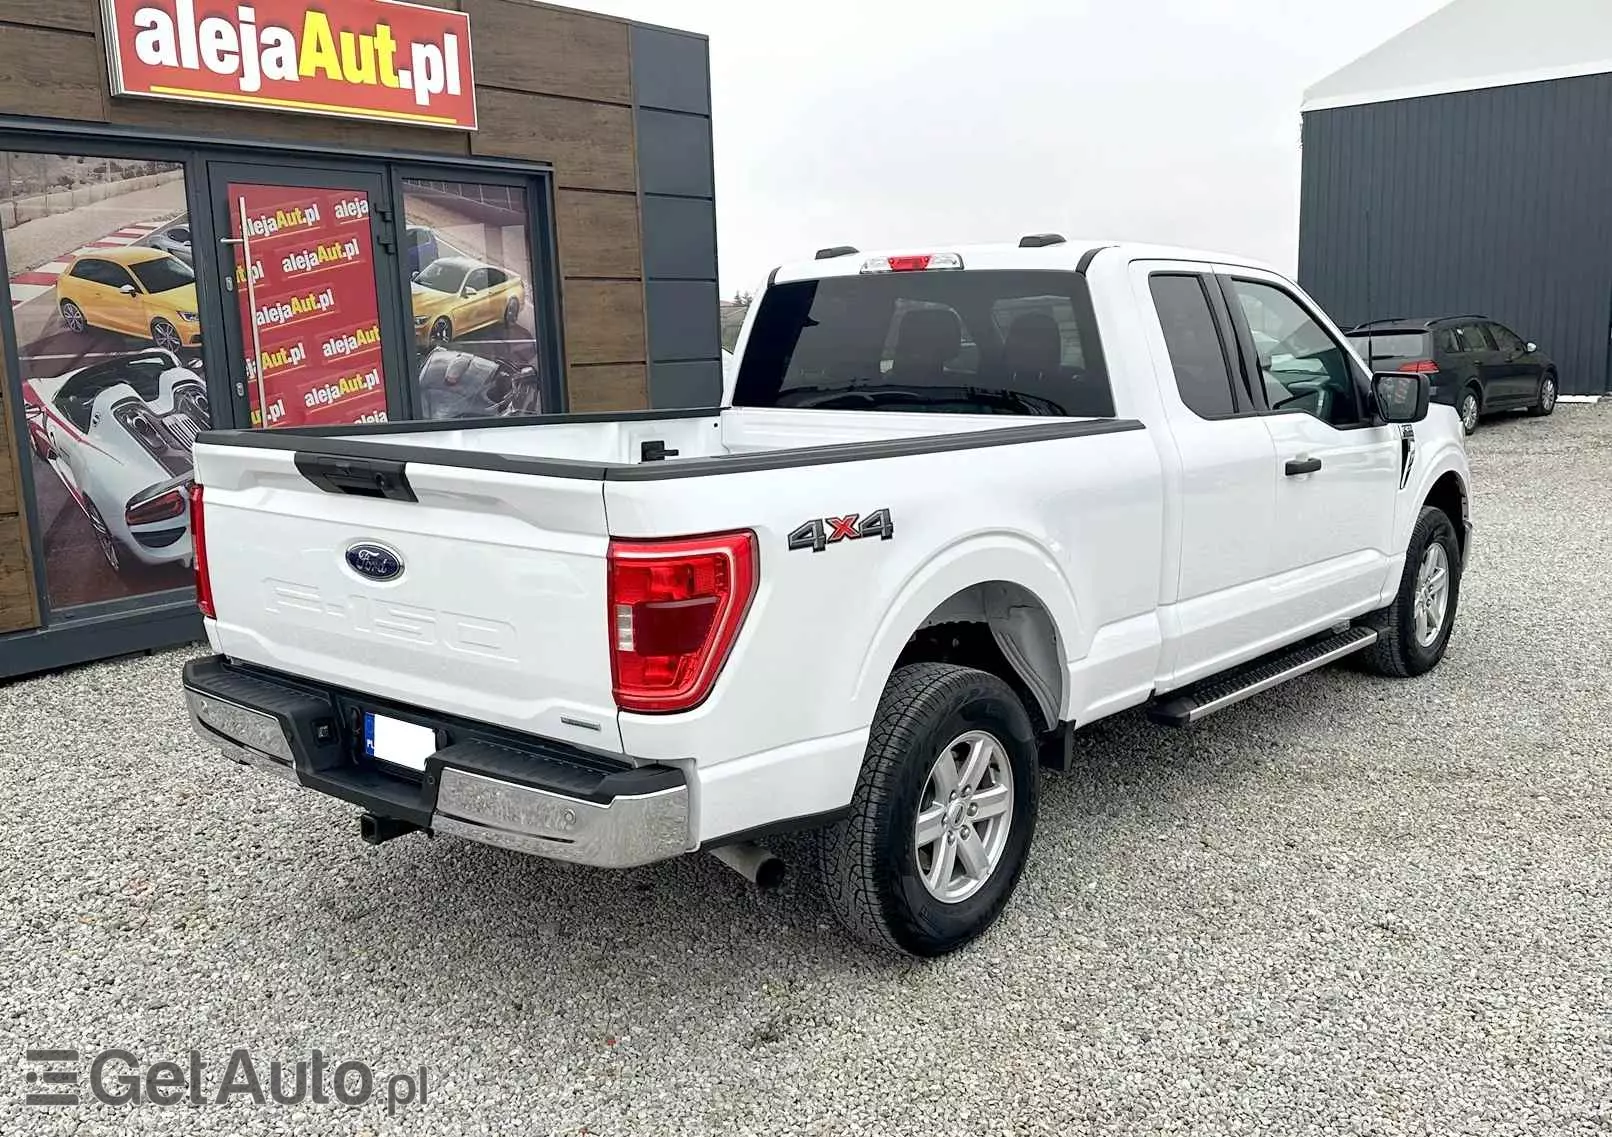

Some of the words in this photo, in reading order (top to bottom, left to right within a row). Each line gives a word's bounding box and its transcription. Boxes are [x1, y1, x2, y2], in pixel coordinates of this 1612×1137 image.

[133, 0, 461, 106] alejaAut.pl
[239, 203, 321, 238] lejaAut.pl
[281, 237, 360, 273] alejaAut.pl
[256, 288, 335, 326] alejaAut.pl
[303, 368, 380, 408] alejaAut.pl
